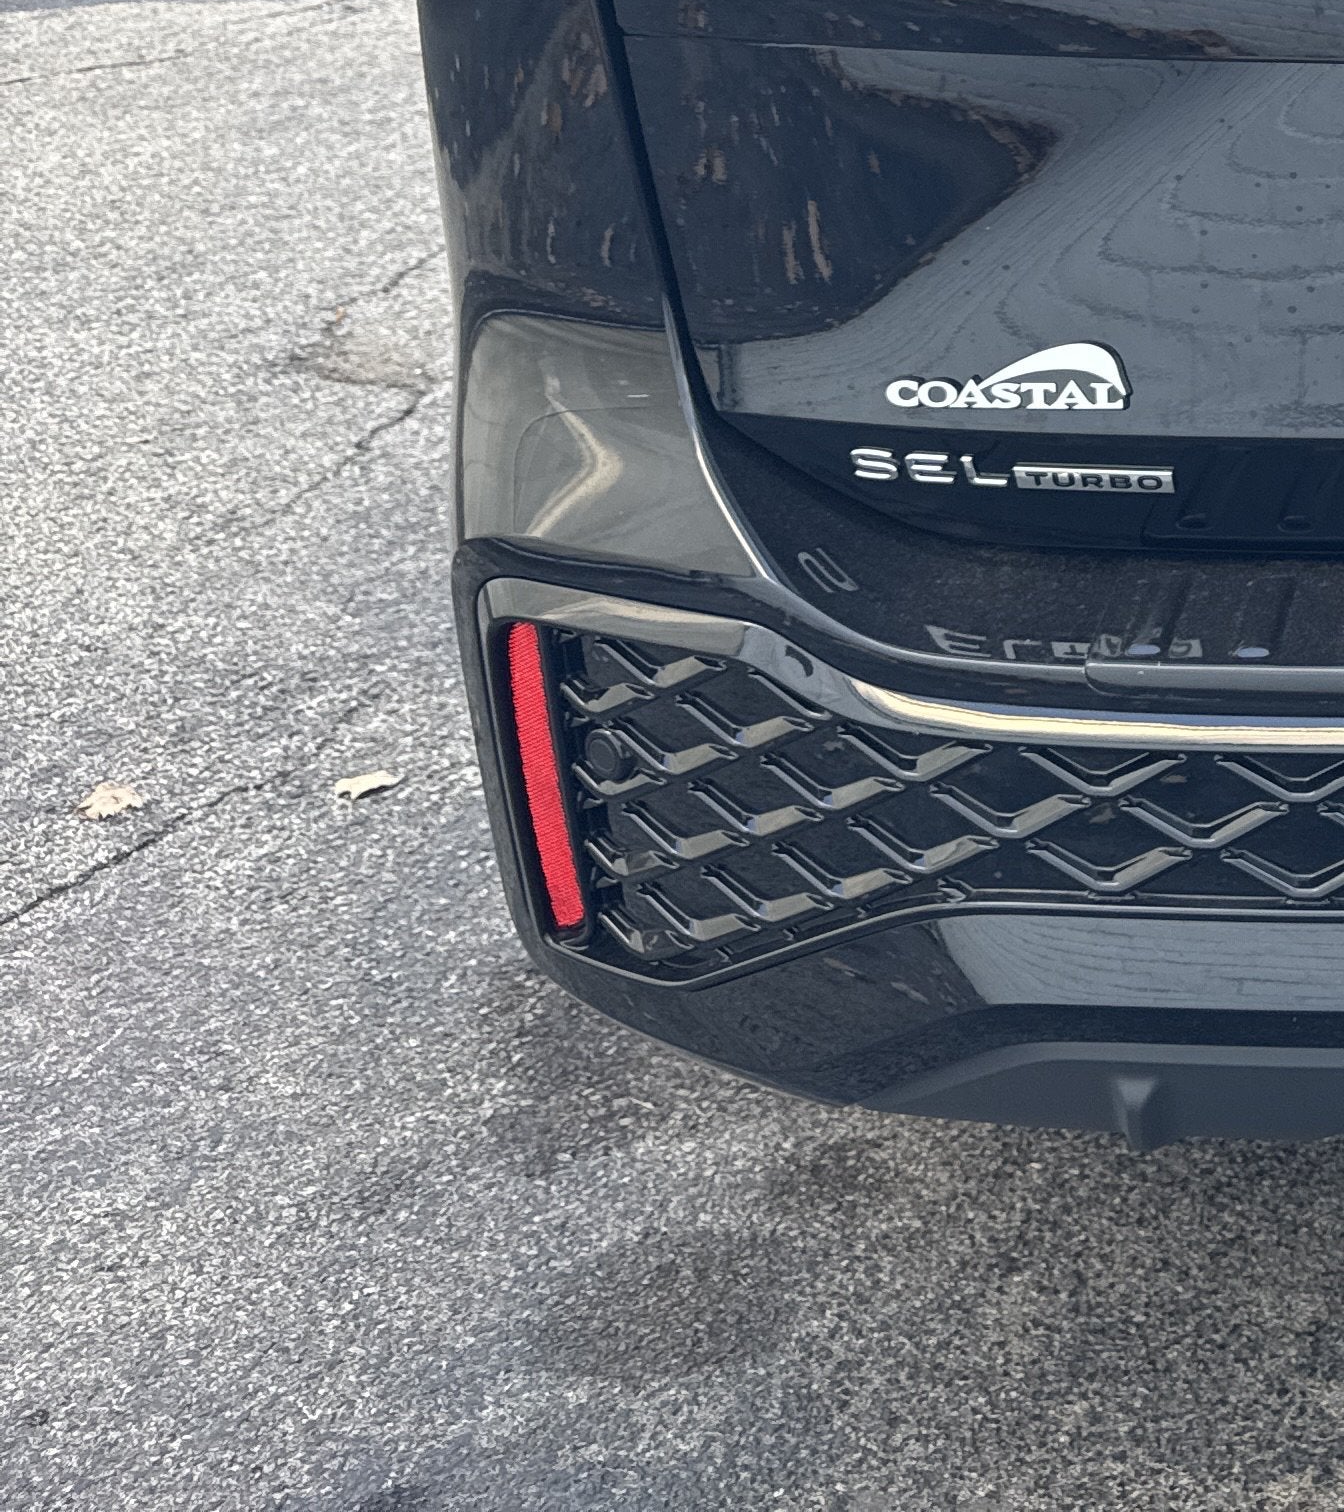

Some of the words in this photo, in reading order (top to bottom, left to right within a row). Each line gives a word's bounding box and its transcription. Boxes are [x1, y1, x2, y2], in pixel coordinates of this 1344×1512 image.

[885, 377, 1126, 411] COASTAL
[849, 445, 1011, 488] SEL
[1024, 470, 1164, 491] TURBO
